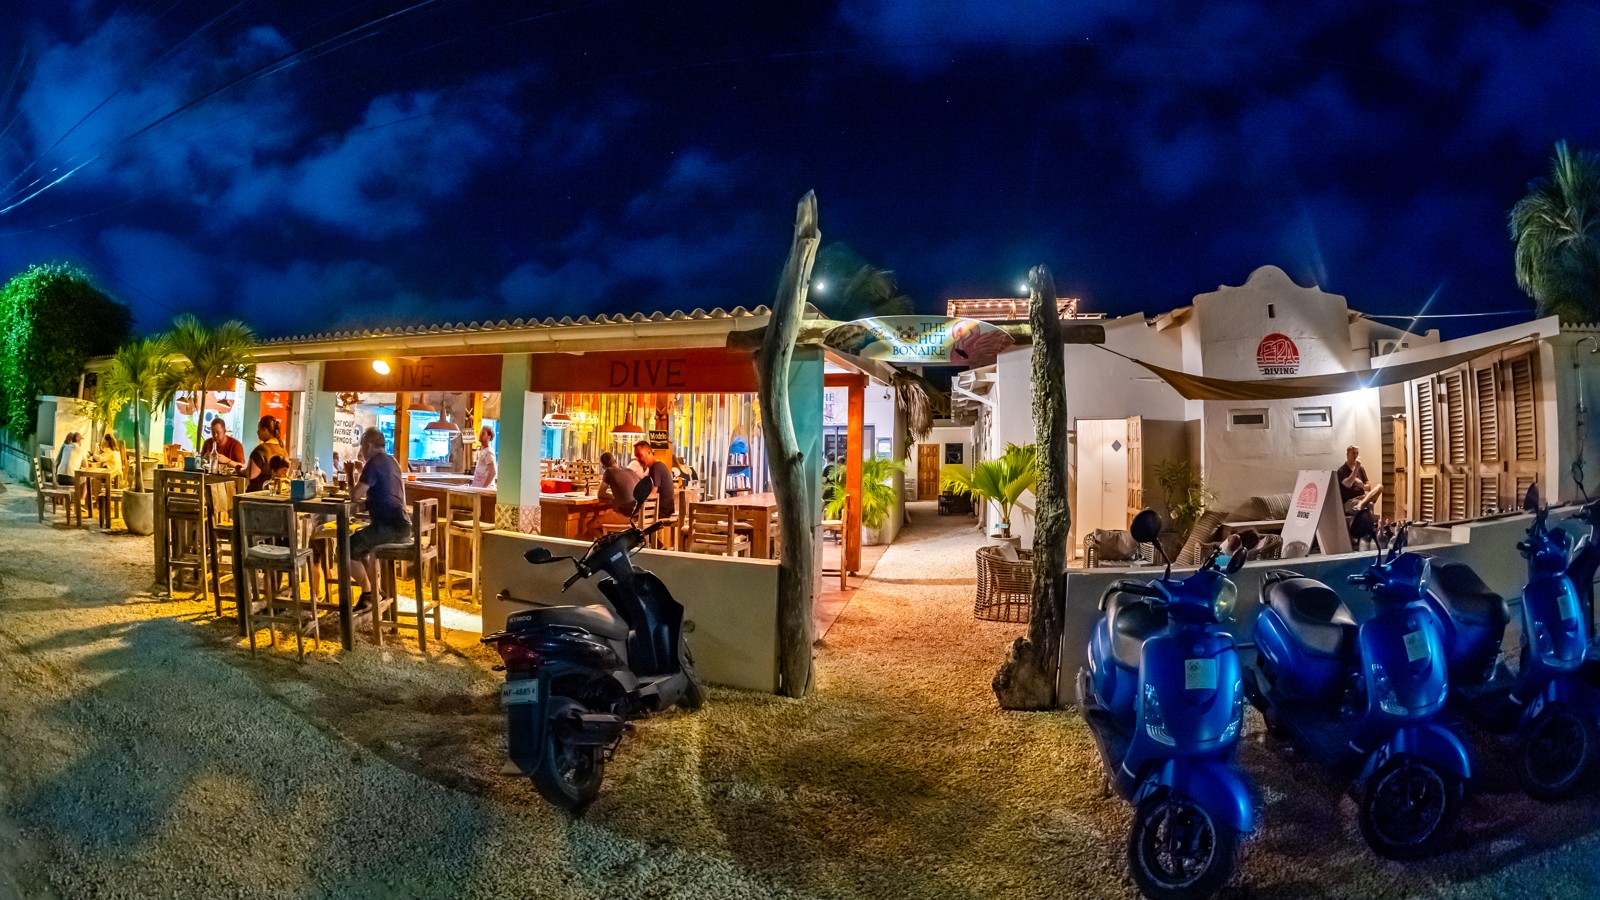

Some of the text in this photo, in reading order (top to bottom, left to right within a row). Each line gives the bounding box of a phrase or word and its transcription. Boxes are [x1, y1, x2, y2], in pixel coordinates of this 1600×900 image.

[920, 322, 946, 333] THE
[918, 334, 946, 345] HUT
[892, 345, 946, 356] BONAIRE
[608, 359, 688, 388] DIVE
[1263, 367, 1296, 375] DIVING
[304, 378, 315, 472] RESTAURANT
